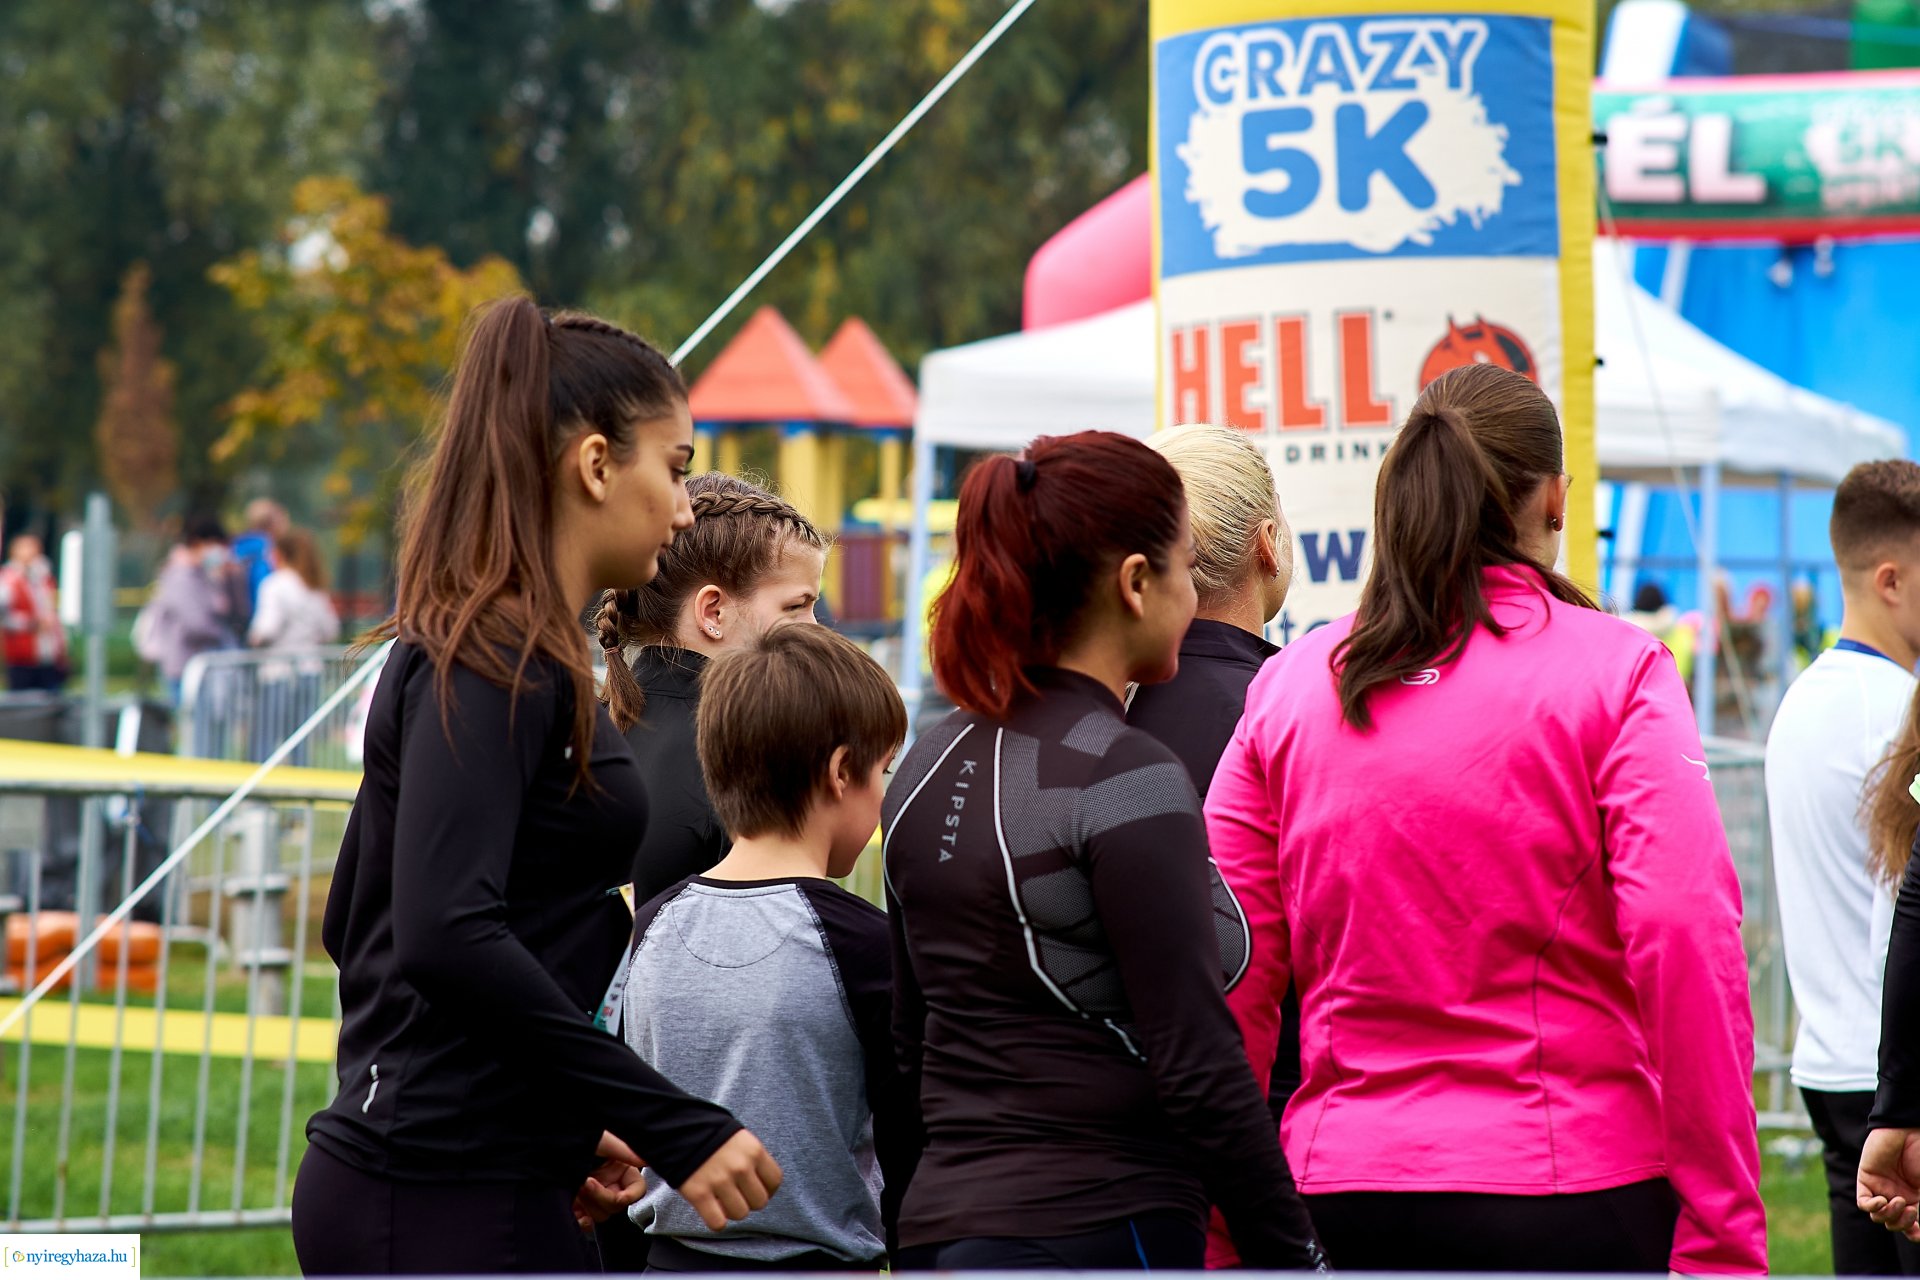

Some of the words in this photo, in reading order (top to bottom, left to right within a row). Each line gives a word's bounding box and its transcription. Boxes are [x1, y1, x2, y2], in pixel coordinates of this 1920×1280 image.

[1194, 20, 1488, 108] CRAZY
[1241, 100, 1438, 219] 5K
[1170, 309, 1396, 432] HELL
[938, 759, 977, 862] KIPSTA
